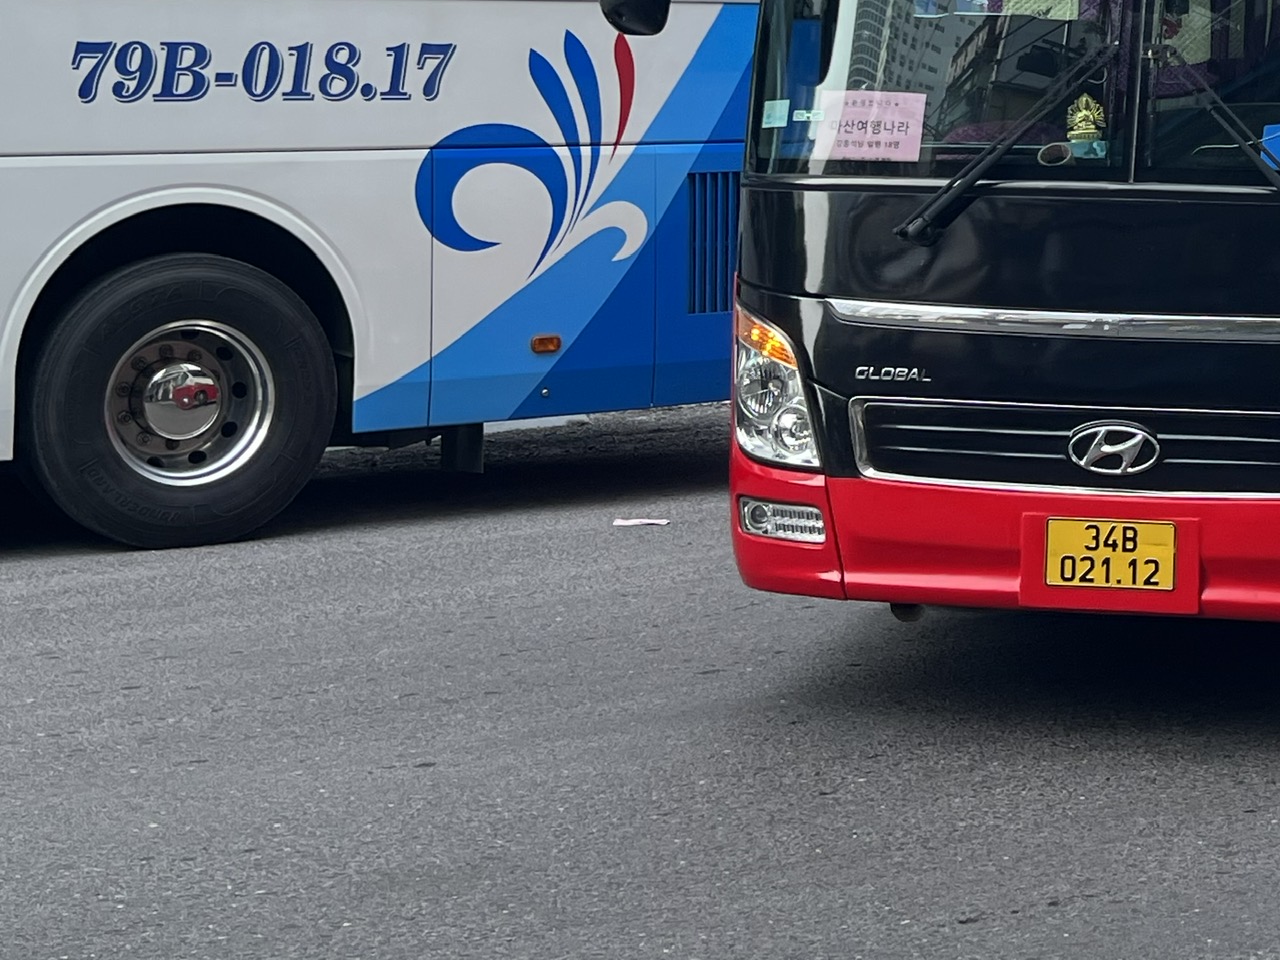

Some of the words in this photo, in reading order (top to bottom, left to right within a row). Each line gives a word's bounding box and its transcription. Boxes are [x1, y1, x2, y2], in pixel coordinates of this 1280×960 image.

[71, 41, 457, 103] 79B-018.17
[854, 366, 932, 382] GLOBAL
[1084, 524, 1138, 553] 34B
[1060, 555, 1160, 586] 021.12
